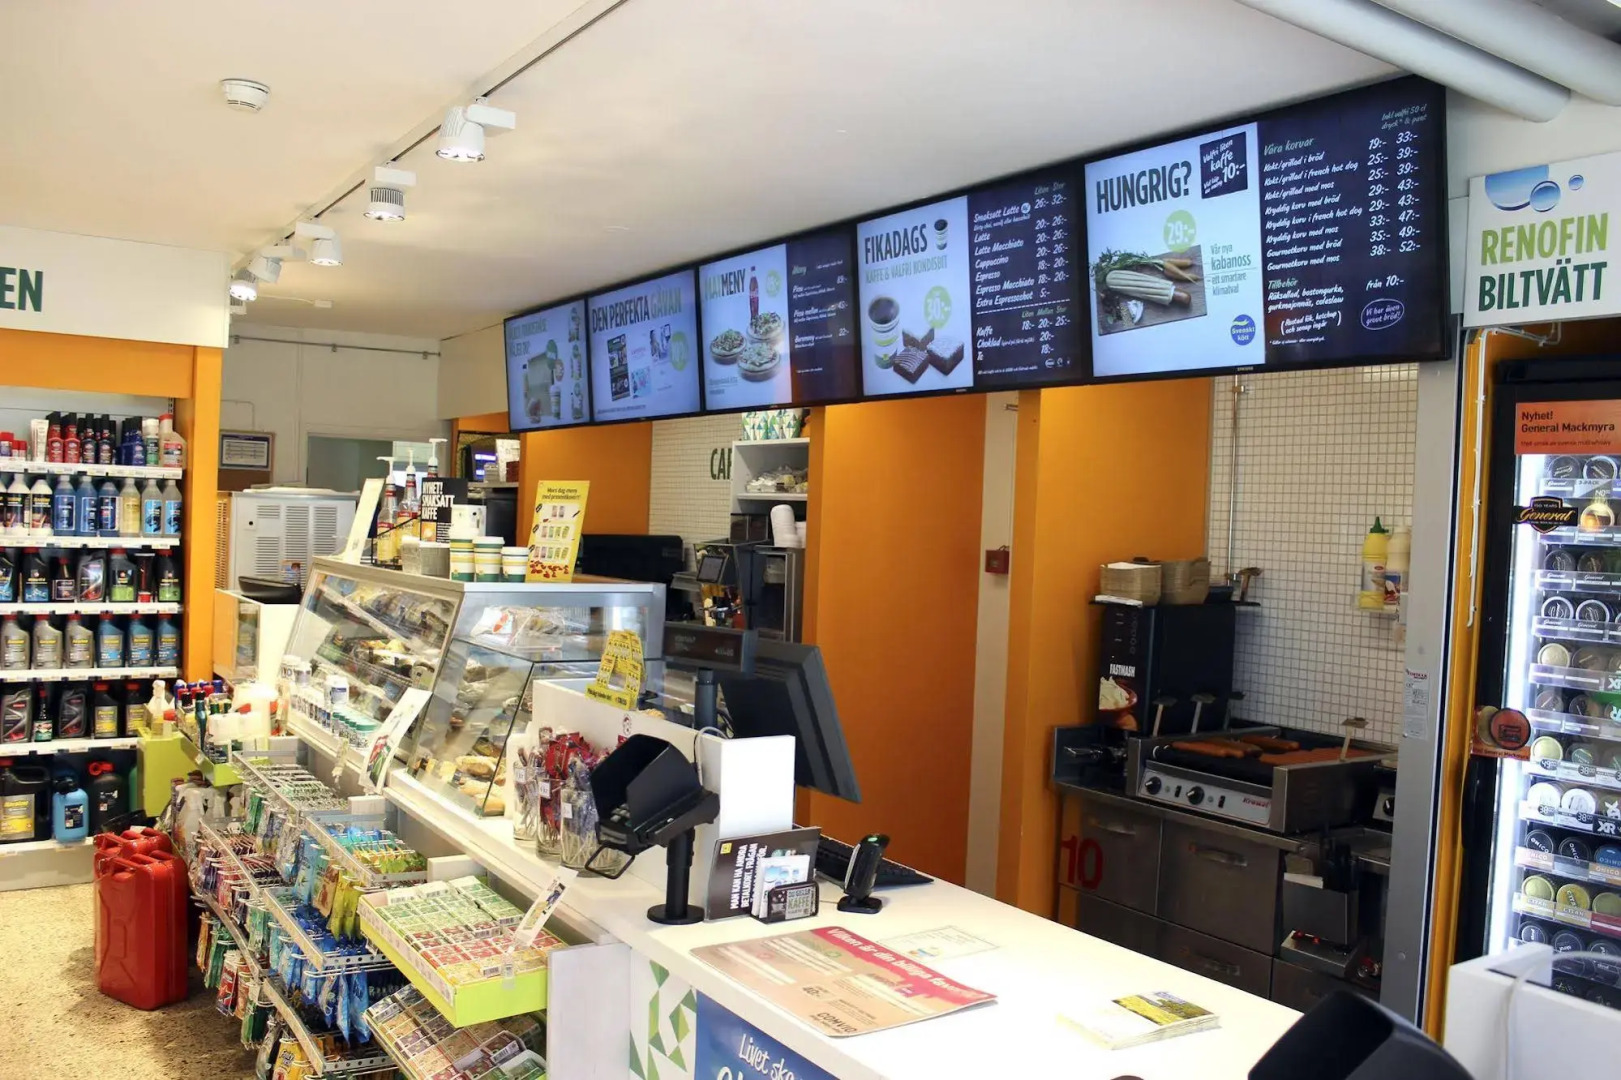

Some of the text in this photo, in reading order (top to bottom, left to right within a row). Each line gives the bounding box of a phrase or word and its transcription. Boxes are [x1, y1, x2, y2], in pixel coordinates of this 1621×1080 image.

[1220, 139, 1233, 152] liten
[1264, 137, 1314, 156] Våra korvar
[1264, 131, 1418, 172] Kokt/grillad bröd 19:- 33:-
[1210, 150, 1234, 172] kaffe
[1264, 146, 1418, 187] Kokt/grillad french hot dog 25:- 39:-
[1222, 163, 1246, 183] 10:-
[1264, 162, 1419, 200] Kokt/grillad med mos 25:- 39:-
[1096, 160, 1192, 214] HUNGRIG?
[1265, 178, 1420, 216] Kryddig korv med bröd 29:- 43:-
[1002, 205, 1020, 217] Latte
[1266, 194, 1420, 230] Kryddig korv french hot dog 29:- 43:-
[974, 232, 990, 243] Latte
[1266, 210, 1420, 245] Kryddig korv med mos 33:- 47:-
[864, 223, 928, 264] FIKADAGS
[974, 246, 990, 256] Latte
[992, 238, 1024, 252] Macchiato
[1266, 225, 1420, 258] Gourmetkorv med bröd 35:- 49:-
[1481, 212, 1608, 266] RENOFIN
[975, 255, 1009, 270] Cappuccino
[1212, 254, 1252, 271] kabanoss
[1267, 240, 1420, 271] Gourmetkorv med mos 38:- 52:-
[866, 255, 948, 284] KAFFE VALFRI KONDISBIT
[976, 271, 1000, 283] Espresso
[1054, 257, 1069, 268] 20:-
[1220, 272, 1246, 284] smartare
[0, 267, 44, 312] EN
[976, 284, 1000, 296] Espresso
[1002, 277, 1034, 290] Macchiato
[1054, 271, 1070, 282] 20:-
[1212, 284, 1239, 296] klimatval
[1268, 286, 1344, 301] Räksallad, bostongurka,
[1366, 280, 1382, 291] från
[1386, 275, 1404, 286] 10:-
[1478, 258, 1608, 312] BILTVÄTT
[976, 298, 993, 308] Extra
[1268, 296, 1344, 313] gurkmajonnäs, coleslaw
[592, 306, 608, 334] DEN
[609, 295, 650, 330] PERFEKTA
[976, 325, 993, 337] Kaffe
[1038, 318, 1053, 328] 20:-
[1055, 315, 1070, 326] 25:-
[1232, 326, 1255, 336] Svenskt
[977, 336, 1002, 348] Choklad
[1040, 330, 1054, 342] 20:-
[1522, 410, 1553, 422] Nyhet!
[1522, 422, 1615, 433] General Mackmyra
[422, 482, 443, 494] NYHET!
[422, 494, 455, 508] SMAKSATT
[422, 508, 438, 520] KAFFE
[1516, 507, 1576, 522] General
[746, 843, 758, 870] FRÅGAN
[1061, 836, 1103, 890] 10
[730, 844, 748, 910] MAN KAN HA ANDRA
[827, 928, 859, 948] Vilken
[860, 943, 876, 954] är
[874, 950, 896, 964] din
[738, 1033, 770, 1074] Livet
